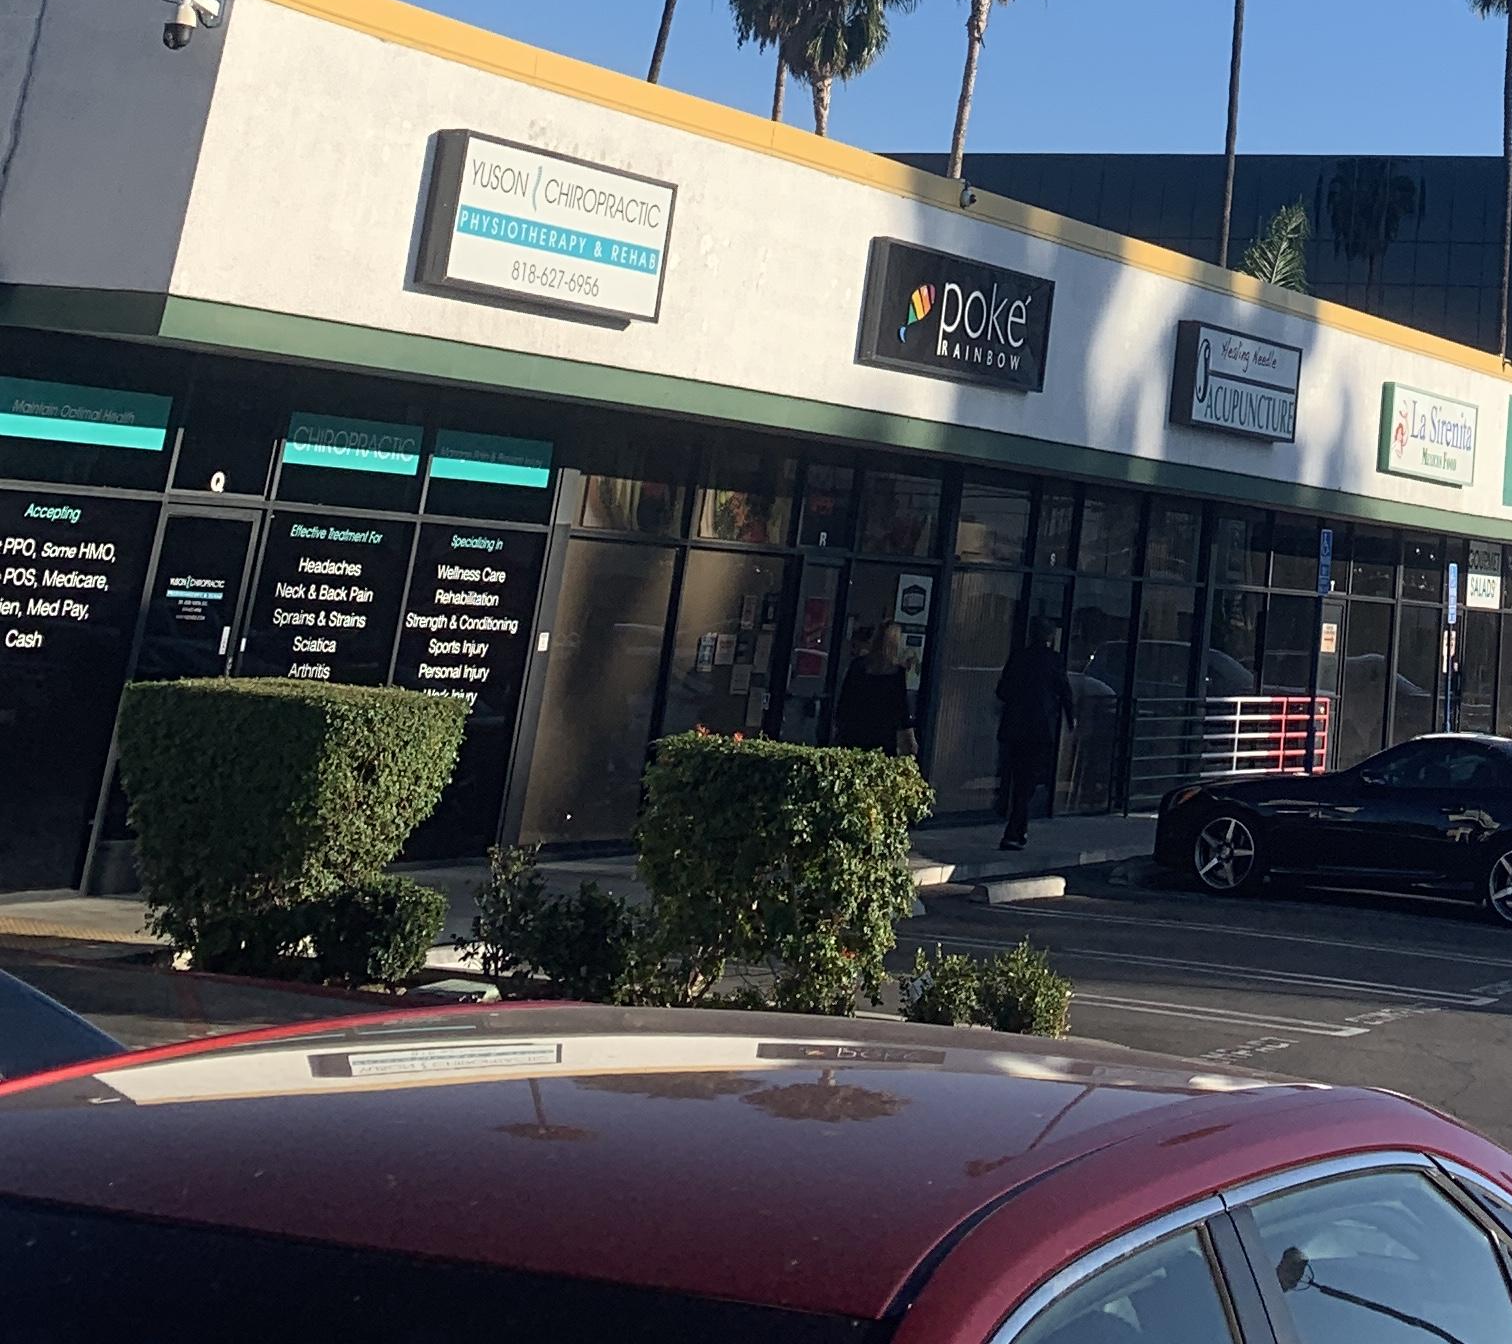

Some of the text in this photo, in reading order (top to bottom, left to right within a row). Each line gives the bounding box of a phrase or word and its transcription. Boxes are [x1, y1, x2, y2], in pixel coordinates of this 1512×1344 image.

[472, 159, 661, 228] YUSON CHIROPRACTIC
[460, 210, 657, 269] PHYSIOTHERAPY & REHAB
[511, 260, 599, 297] 818-627-6956
[937, 282, 1031, 355] poké
[942, 340, 1020, 370] RAINBOW
[12, 399, 58, 416] Maintain
[1204, 384, 1294, 433] ACUPUNCTURE
[1410, 400, 1472, 451] La Sirenita
[293, 425, 416, 462] CHIROPRACTIC
[211, 471, 225, 493] Q
[24, 503, 81, 523] Accepting
[290, 524, 383, 543] Effective Treatment For
[451, 534, 495, 552] Specializing
[819, 531, 828, 547] R
[3, 537, 116, 563] PPO, Some HMO,
[298, 557, 362, 576] Headaches
[437, 564, 506, 583] Wellness Care
[3, 567, 109, 591] POS, Medicare,
[275, 582, 373, 603] Neck & Back Pain
[435, 589, 499, 606] Rehabilitation
[0, 597, 90, 621] ien, Med Pay,
[273, 608, 366, 628] Sprains & Strains
[405, 613, 519, 634] Strength & Conditioning
[5, 629, 43, 648] Cash
[292, 636, 337, 653] Sciatica
[428, 638, 489, 657] Sports Injury
[288, 663, 330, 679] Arthritis
[418, 663, 490, 682] Personal Injury
